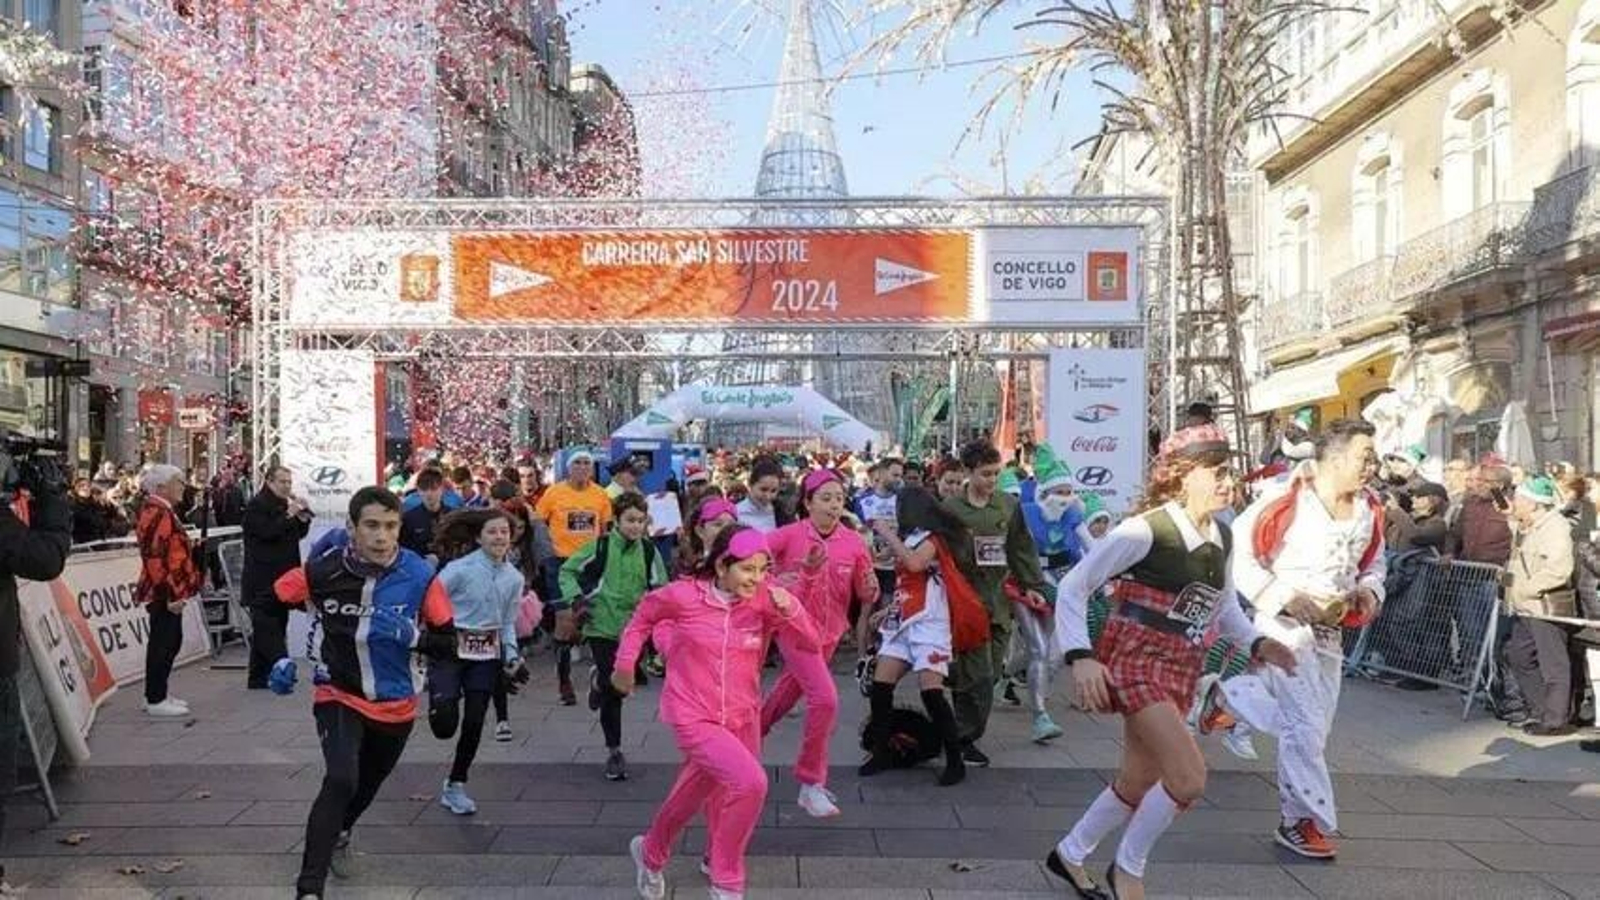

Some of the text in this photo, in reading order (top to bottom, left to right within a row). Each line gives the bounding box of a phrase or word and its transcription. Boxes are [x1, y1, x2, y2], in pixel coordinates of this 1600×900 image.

[582, 239, 810, 266] CARREIRA SAN SILVESTRE
[993, 261, 1076, 275] CONCELLO
[772, 279, 839, 312] 2024
[1002, 277, 1067, 290] DE VIGO
[98, 623, 127, 653] DE
